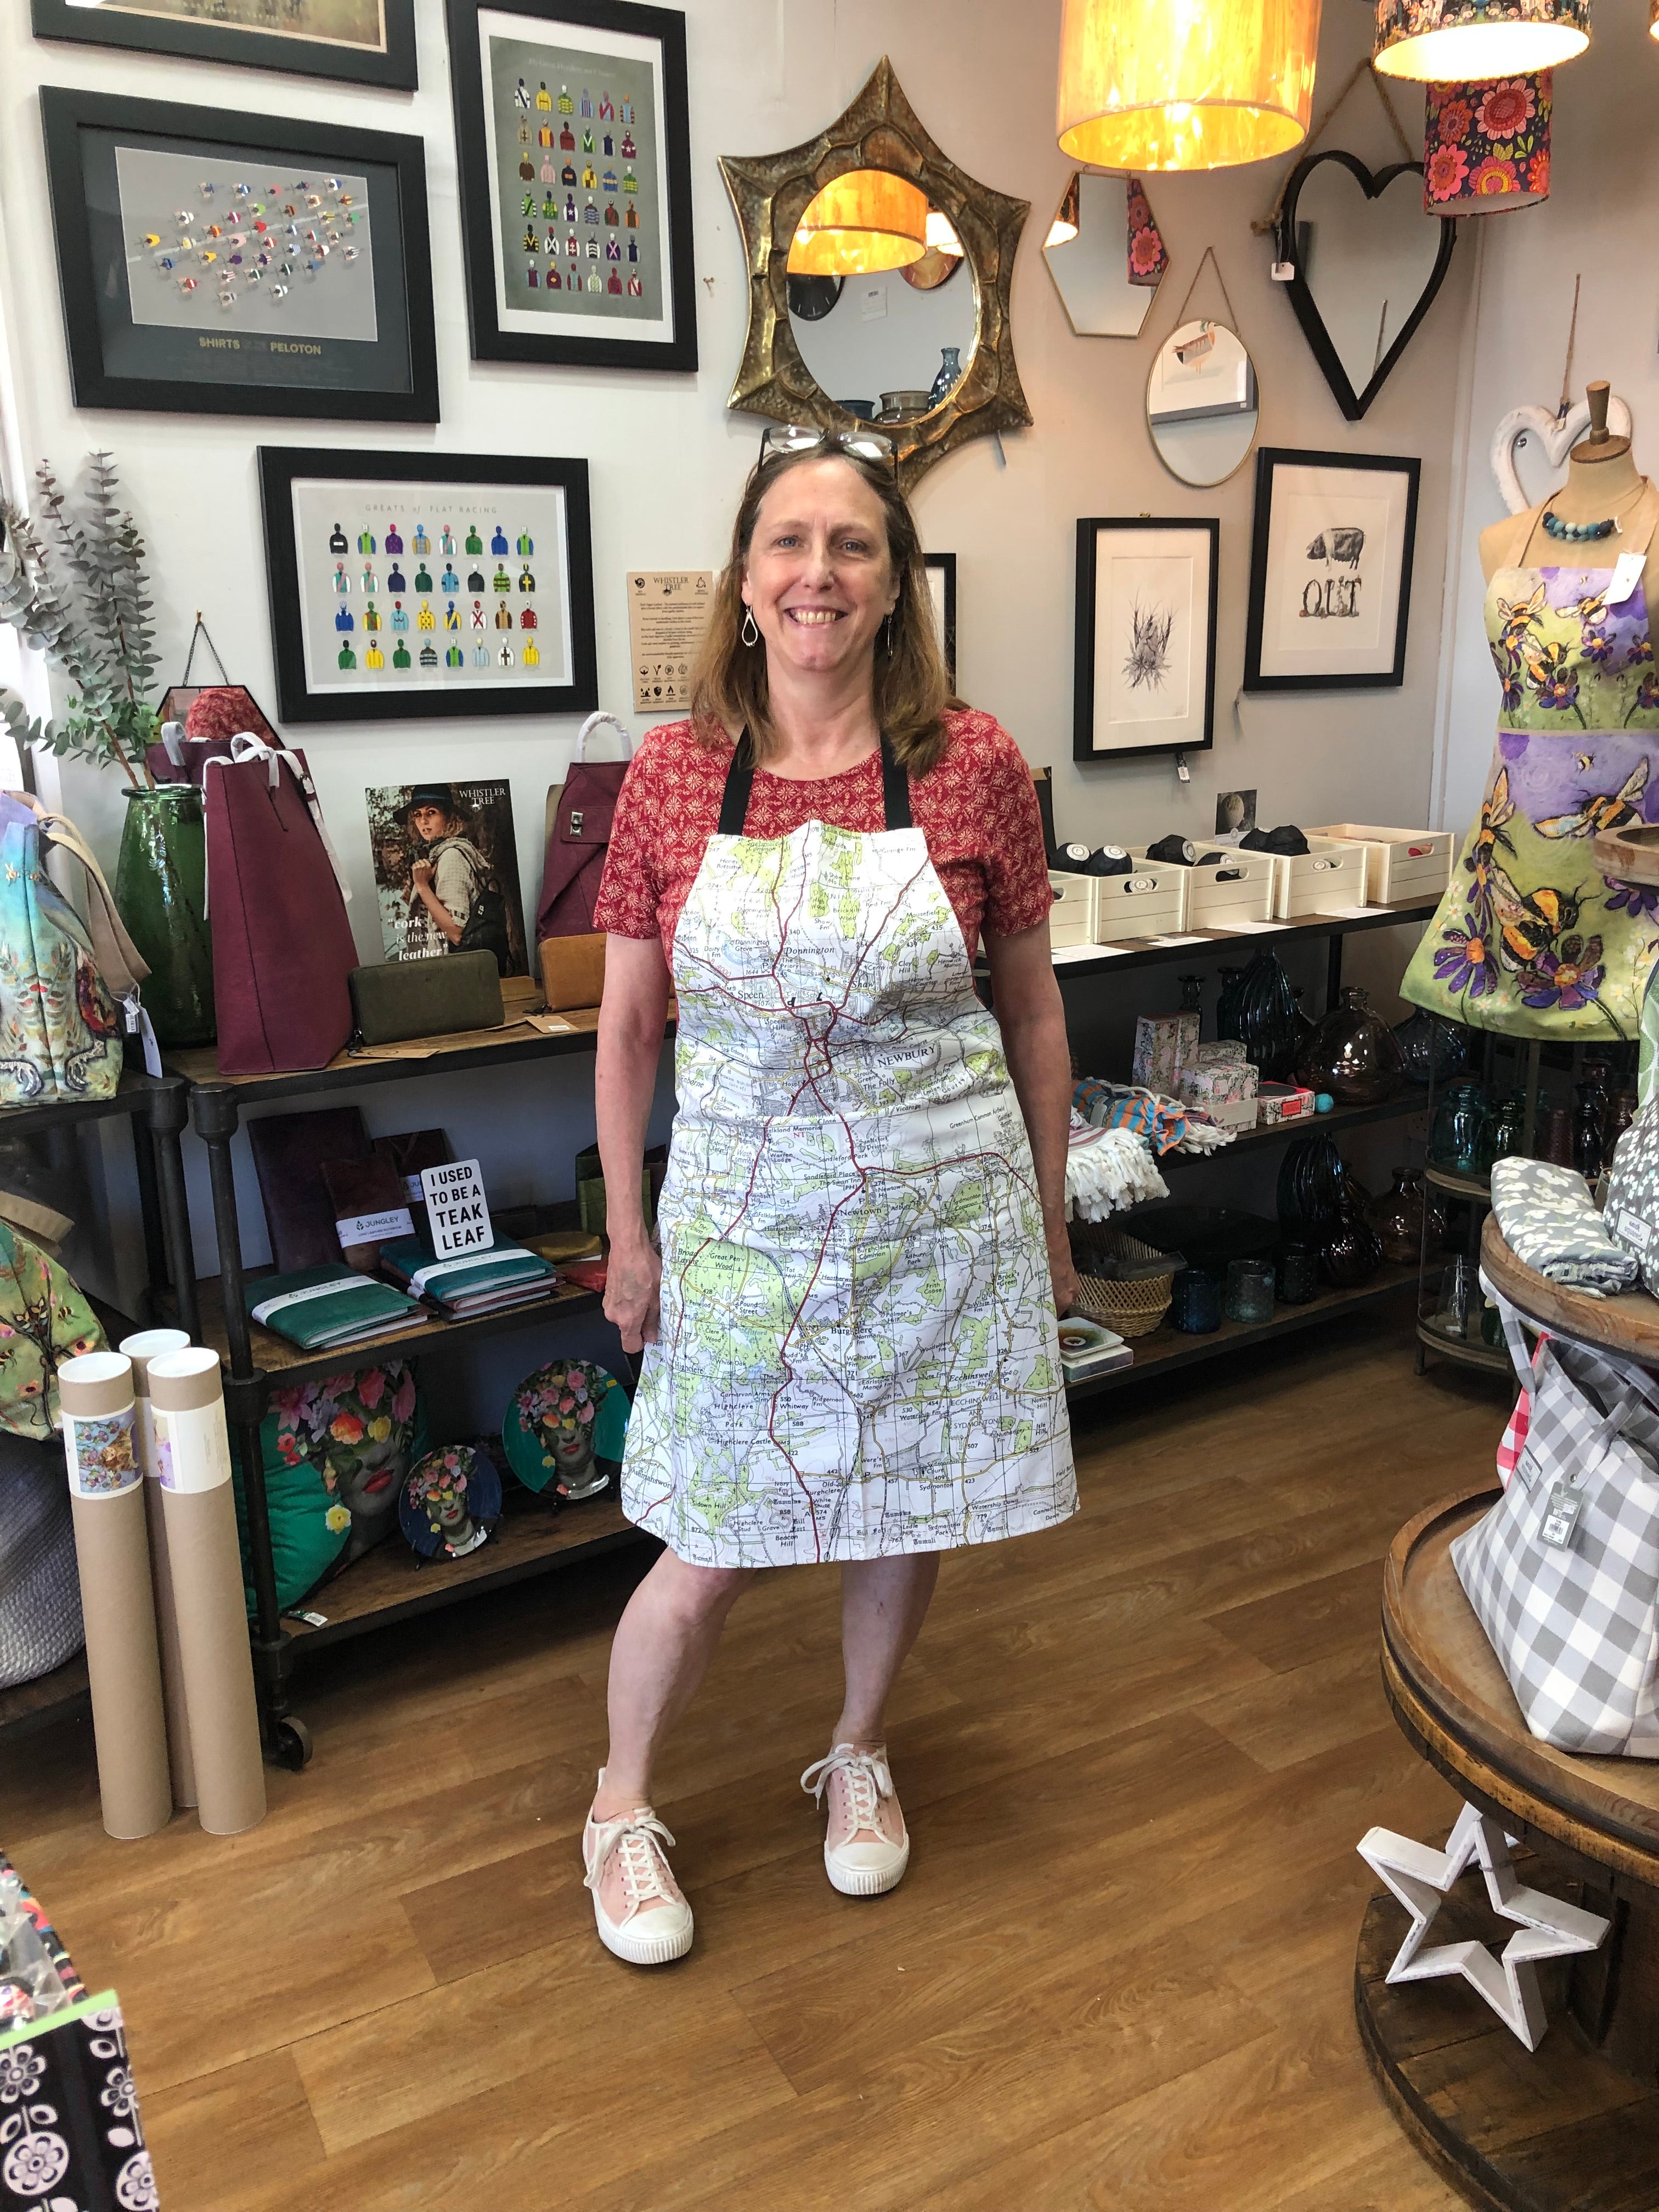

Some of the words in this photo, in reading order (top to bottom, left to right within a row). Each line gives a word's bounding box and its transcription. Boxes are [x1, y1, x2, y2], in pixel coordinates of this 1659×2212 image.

[198, 337, 240, 349] SHIRTS
[270, 342, 321, 355] PELOTON
[459, 787, 506, 798] WHISTLER
[471, 796, 495, 805] TREE
[396, 933, 405, 943] is
[408, 932, 424, 943] the
[425, 931, 447, 941] new
[786, 947, 834, 955] Donnington
[851, 980, 874, 989] Shaw
[738, 991, 764, 1001] Speen
[877, 1045, 936, 1068] NEWBURY
[878, 1079, 895, 1087] Folly
[896, 1104, 921, 1112] Vicarage
[431, 1174, 436, 1186] I
[439, 1166, 473, 1184] USED
[430, 1192, 448, 1206] TO
[452, 1188, 469, 1201] BE
[472, 1184, 481, 1198] A
[953, 1194, 981, 1205] Sydmonton
[955, 1201, 978, 1210] Common
[436, 1204, 483, 1228] TEAK
[840, 1207, 882, 1216] Newtown
[365, 1216, 398, 1228] JUNGLEY
[442, 1226, 485, 1250] LEAF
[859, 1251, 886, 1260] Common
[997, 1272, 1020, 1281] Brock's
[831, 1327, 872, 1336] Burghclere
[675, 1361, 705, 1374] Highclere
[949, 1370, 994, 1382] Ecchinswell
[951, 1395, 1000, 1406] ECCHINSWELL
[954, 1418, 998, 1429] SYDMONTON
[645, 1435, 654, 1444] 792
[927, 1459, 960, 1467] Sydmonton
[919, 1482, 954, 1491] Sydmonton
[692, 1500, 715, 1509] Sidown
[972, 1502, 1002, 1511] Watership
